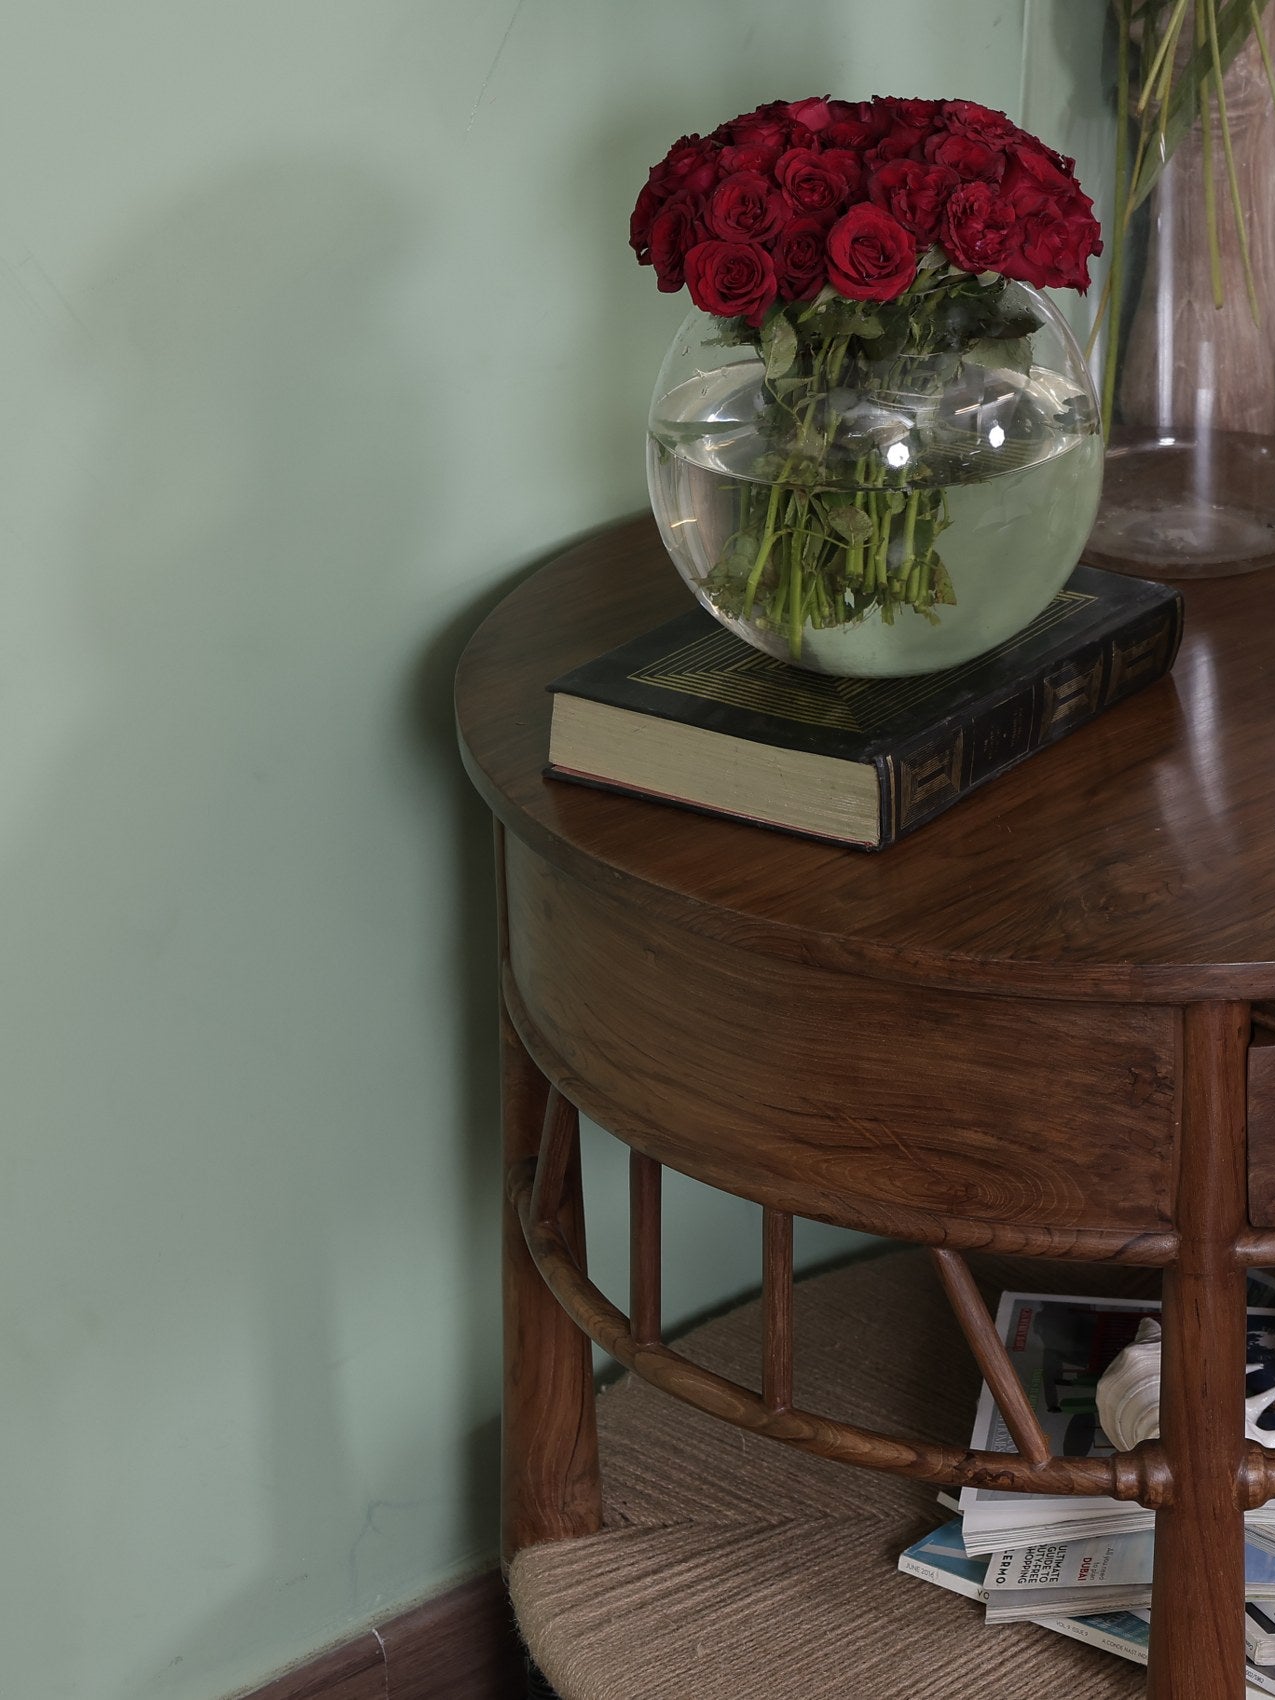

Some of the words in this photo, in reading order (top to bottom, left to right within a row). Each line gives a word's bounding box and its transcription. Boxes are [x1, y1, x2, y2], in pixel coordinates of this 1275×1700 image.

[996, 1549, 1015, 1584] LERMO
[1042, 1546, 1057, 1570] GUIDE
[1049, 1545, 1068, 1582] ULTIMATE
[906, 1562, 920, 1573] JUNE
[920, 1568, 934, 1578] 2016
[1039, 1572, 1049, 1583] TO
[1078, 1557, 1092, 1581] DUBAI
[977, 1589, 990, 1600] VO
[1124, 1647, 1137, 1656] NAST
